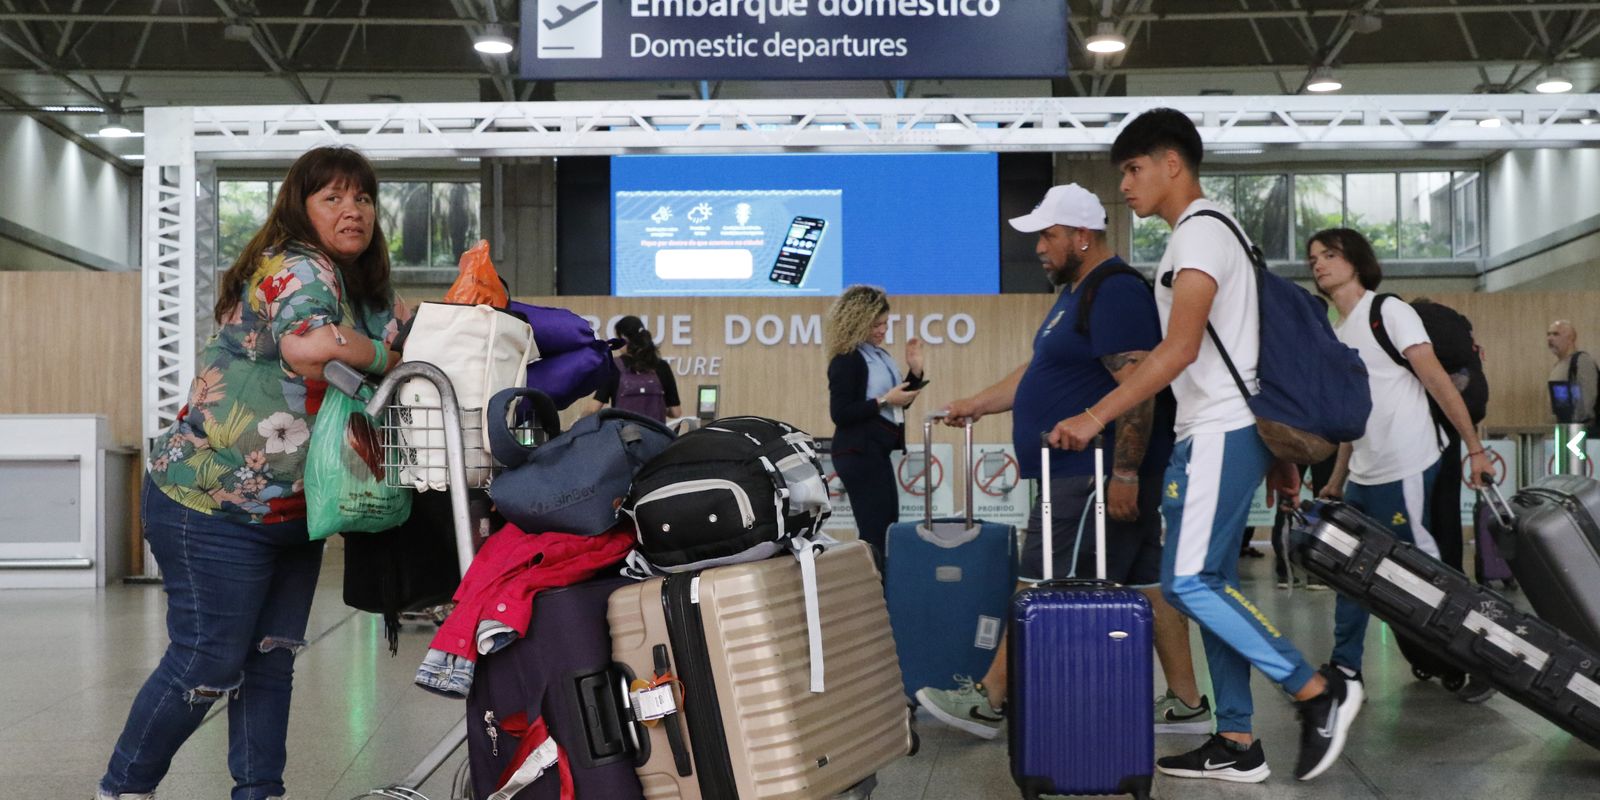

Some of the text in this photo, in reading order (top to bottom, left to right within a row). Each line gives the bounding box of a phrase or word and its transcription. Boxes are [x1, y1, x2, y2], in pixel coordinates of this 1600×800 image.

[630, 31, 908, 63] Domestic departures
[725, 313, 976, 345] DOMTICO
[901, 504, 938, 512] PROIBO
[977, 504, 1015, 512] PROIBIDO
